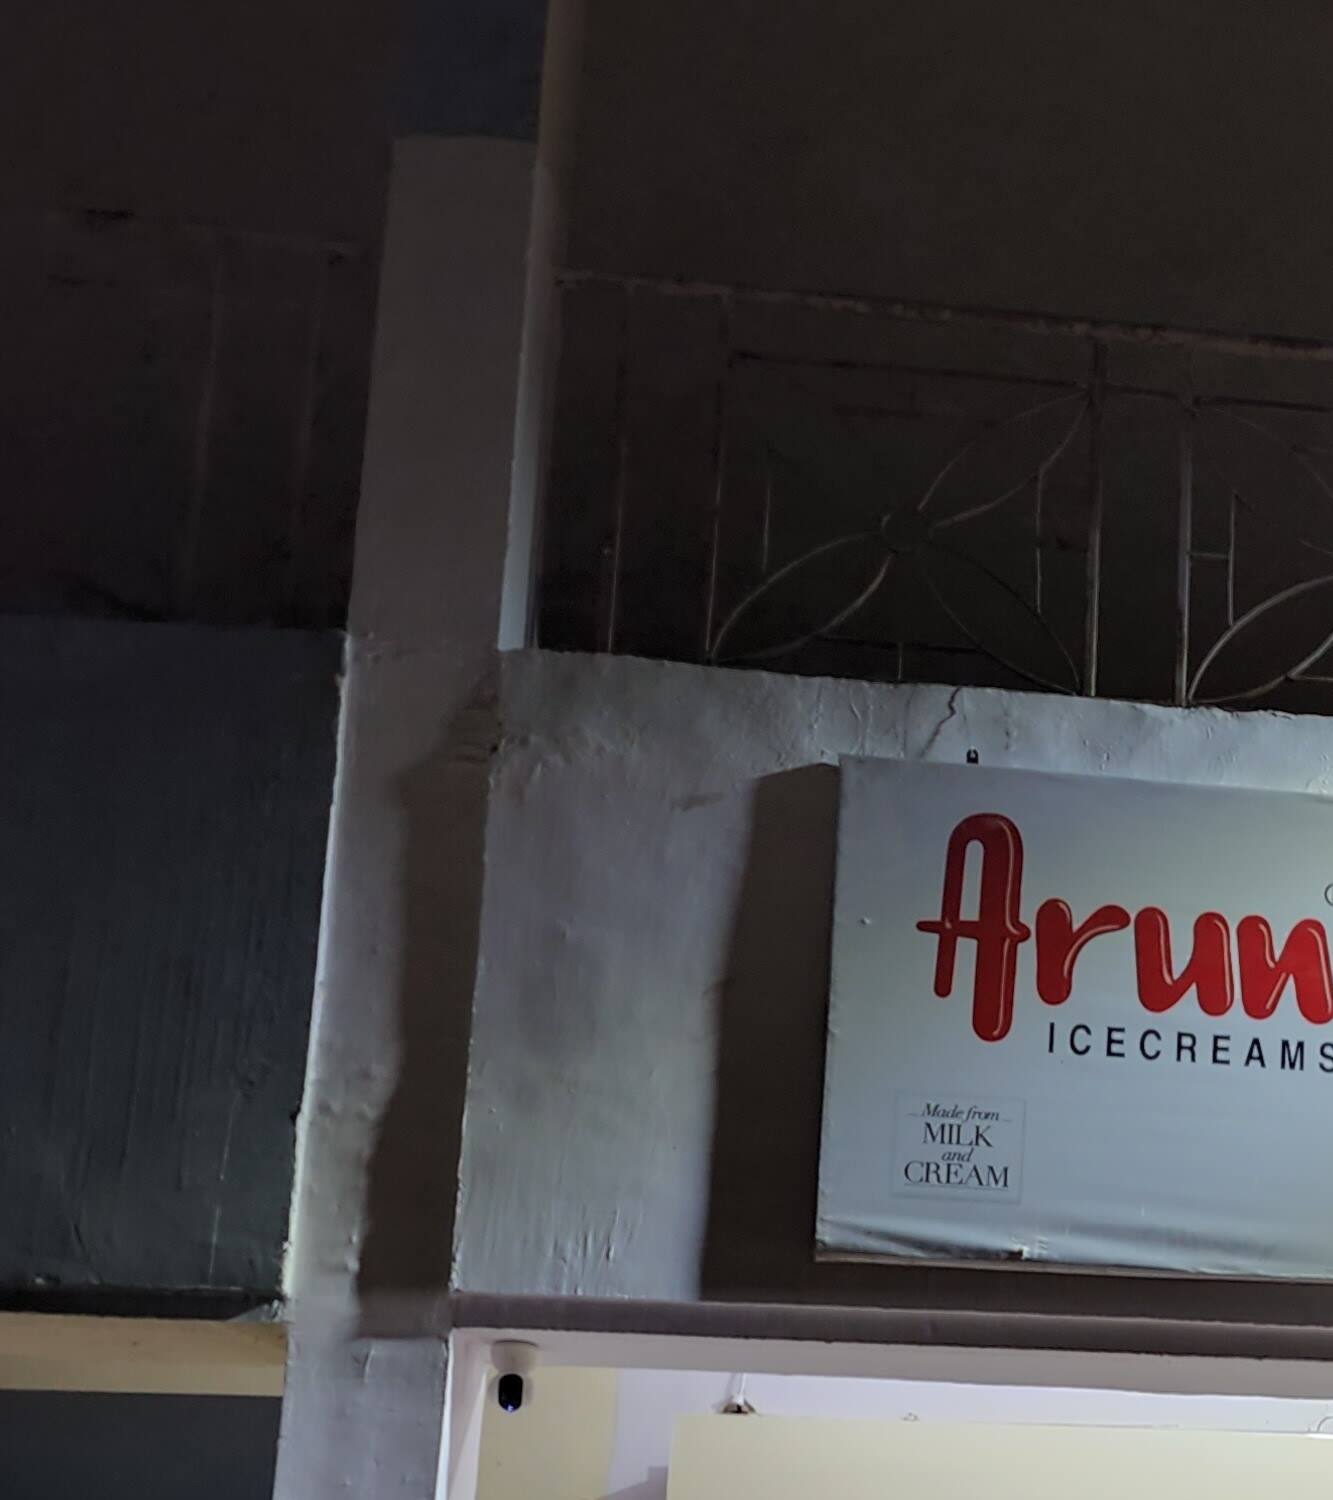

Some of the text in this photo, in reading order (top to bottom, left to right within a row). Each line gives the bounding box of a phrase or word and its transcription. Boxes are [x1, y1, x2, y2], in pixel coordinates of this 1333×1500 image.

[921, 1102, 1000, 1122] Made from
[922, 1122, 993, 1148] MILK
[941, 1147, 974, 1162] and
[904, 1160, 1009, 1188] CREAM
